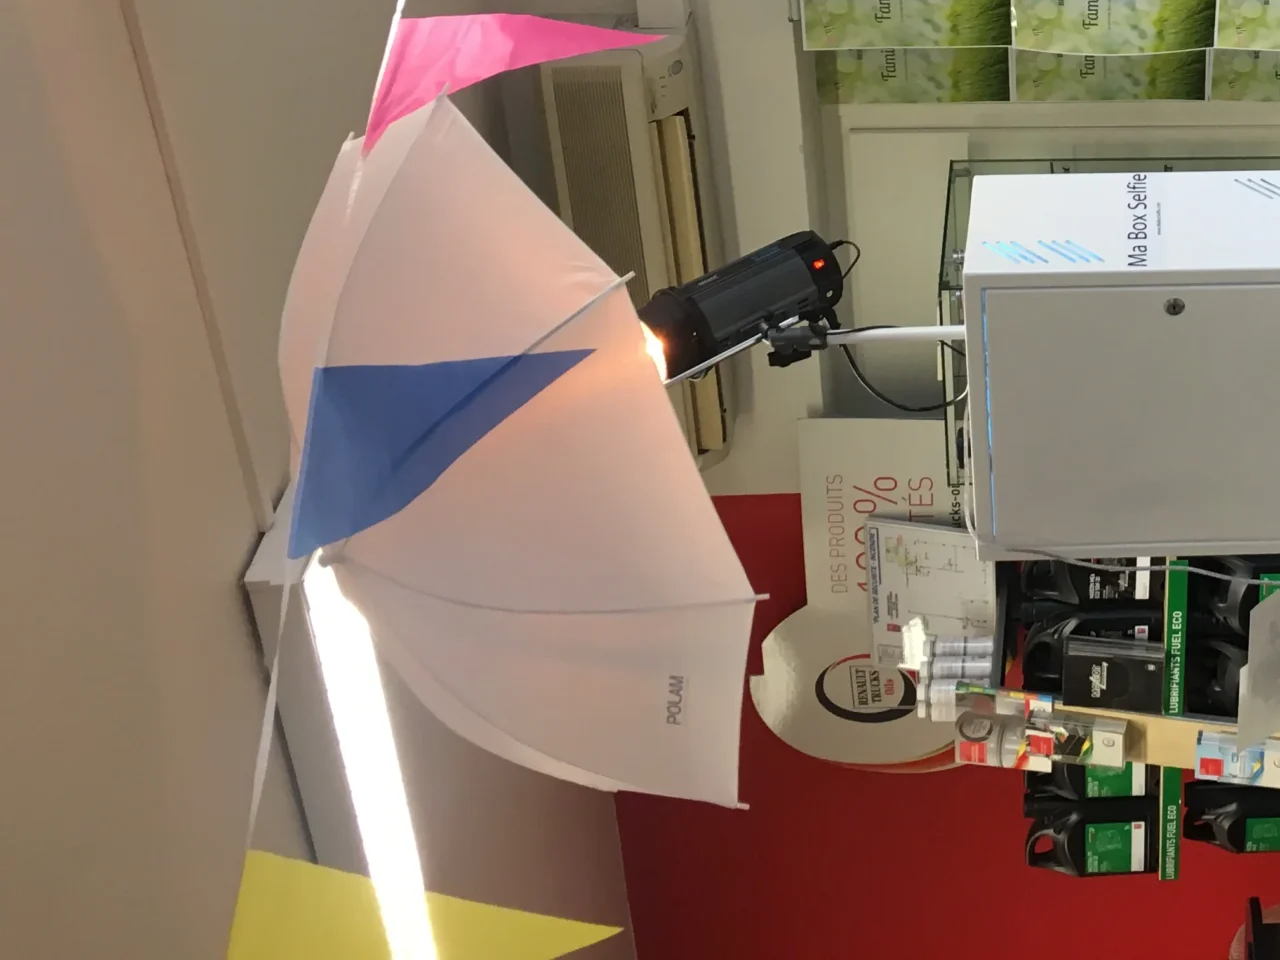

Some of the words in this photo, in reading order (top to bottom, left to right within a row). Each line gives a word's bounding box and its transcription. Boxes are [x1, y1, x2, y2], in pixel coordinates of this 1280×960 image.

[881, 48, 896, 81] Fami
[1127, 174, 1147, 210] Selfie
[1127, 214, 1147, 240] Box
[1127, 245, 1147, 267] Ma
[826, 474, 845, 558] PRODUITS
[831, 564, 848, 593] DES
[872, 596, 878, 605] DE
[1173, 610, 1182, 629] ECO
[1173, 631, 1182, 654] FUEL
[855, 668, 868, 706] RENAULT
[869, 671, 881, 703] TRUCKS
[884, 679, 894, 696] Oils
[1169, 657, 1181, 713] LUBRIFIANTS
[666, 675, 684, 726] POLAM
[1167, 805, 1177, 819] ECO
[1167, 820, 1176, 838] FUEL
[1165, 839, 1176, 879] LUBRIFIANTS
